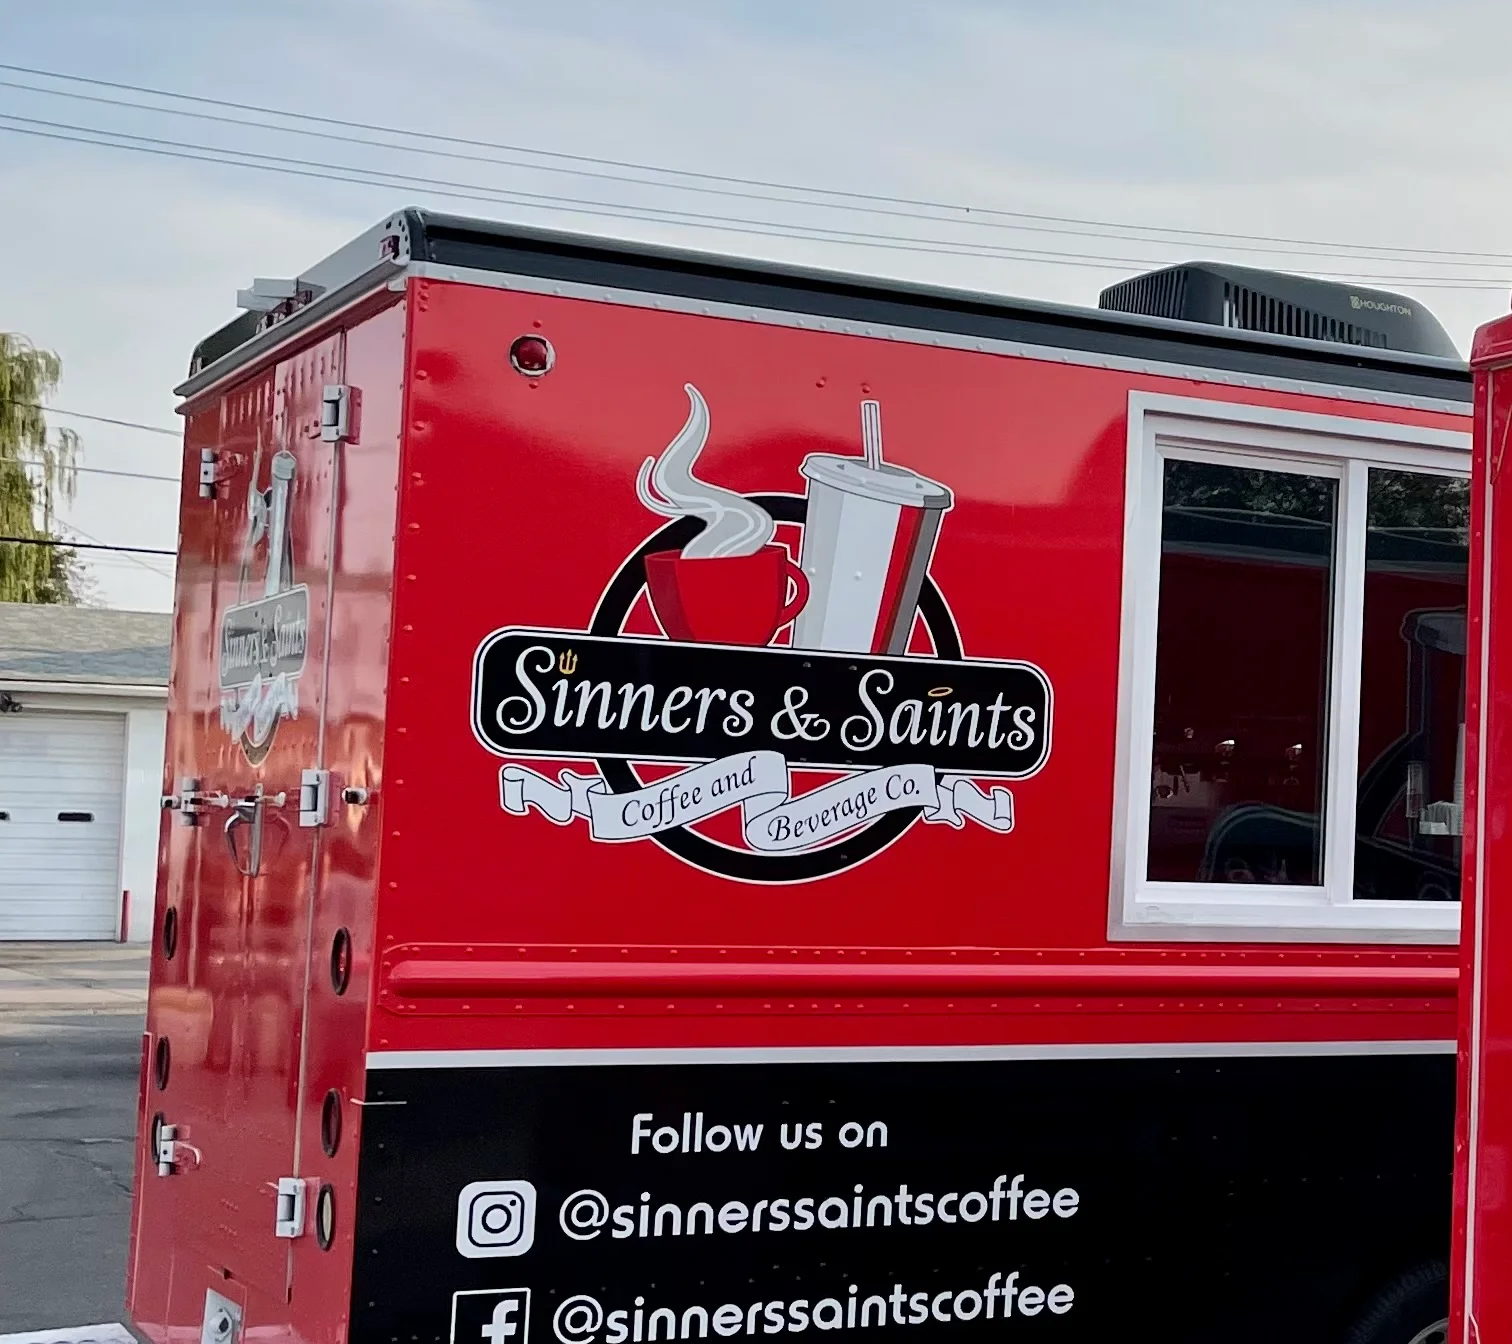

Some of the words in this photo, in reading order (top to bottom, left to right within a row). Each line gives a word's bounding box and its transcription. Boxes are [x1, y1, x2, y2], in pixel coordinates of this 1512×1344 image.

[1360, 299, 1411, 316] HOUGHTON
[496, 646, 754, 737] Sinners
[771, 686, 830, 740] &
[840, 669, 1037, 751] Saints
[621, 783, 703, 829] Coffee
[710, 763, 756, 801] and
[767, 787, 878, 843] Beverage
[884, 770, 921, 805] Co.
[631, 1112, 764, 1154] Follow
[780, 1121, 822, 1150] us
[839, 1120, 888, 1149] on
[559, 1174, 1080, 1241] @sinnerssaintscoffee
